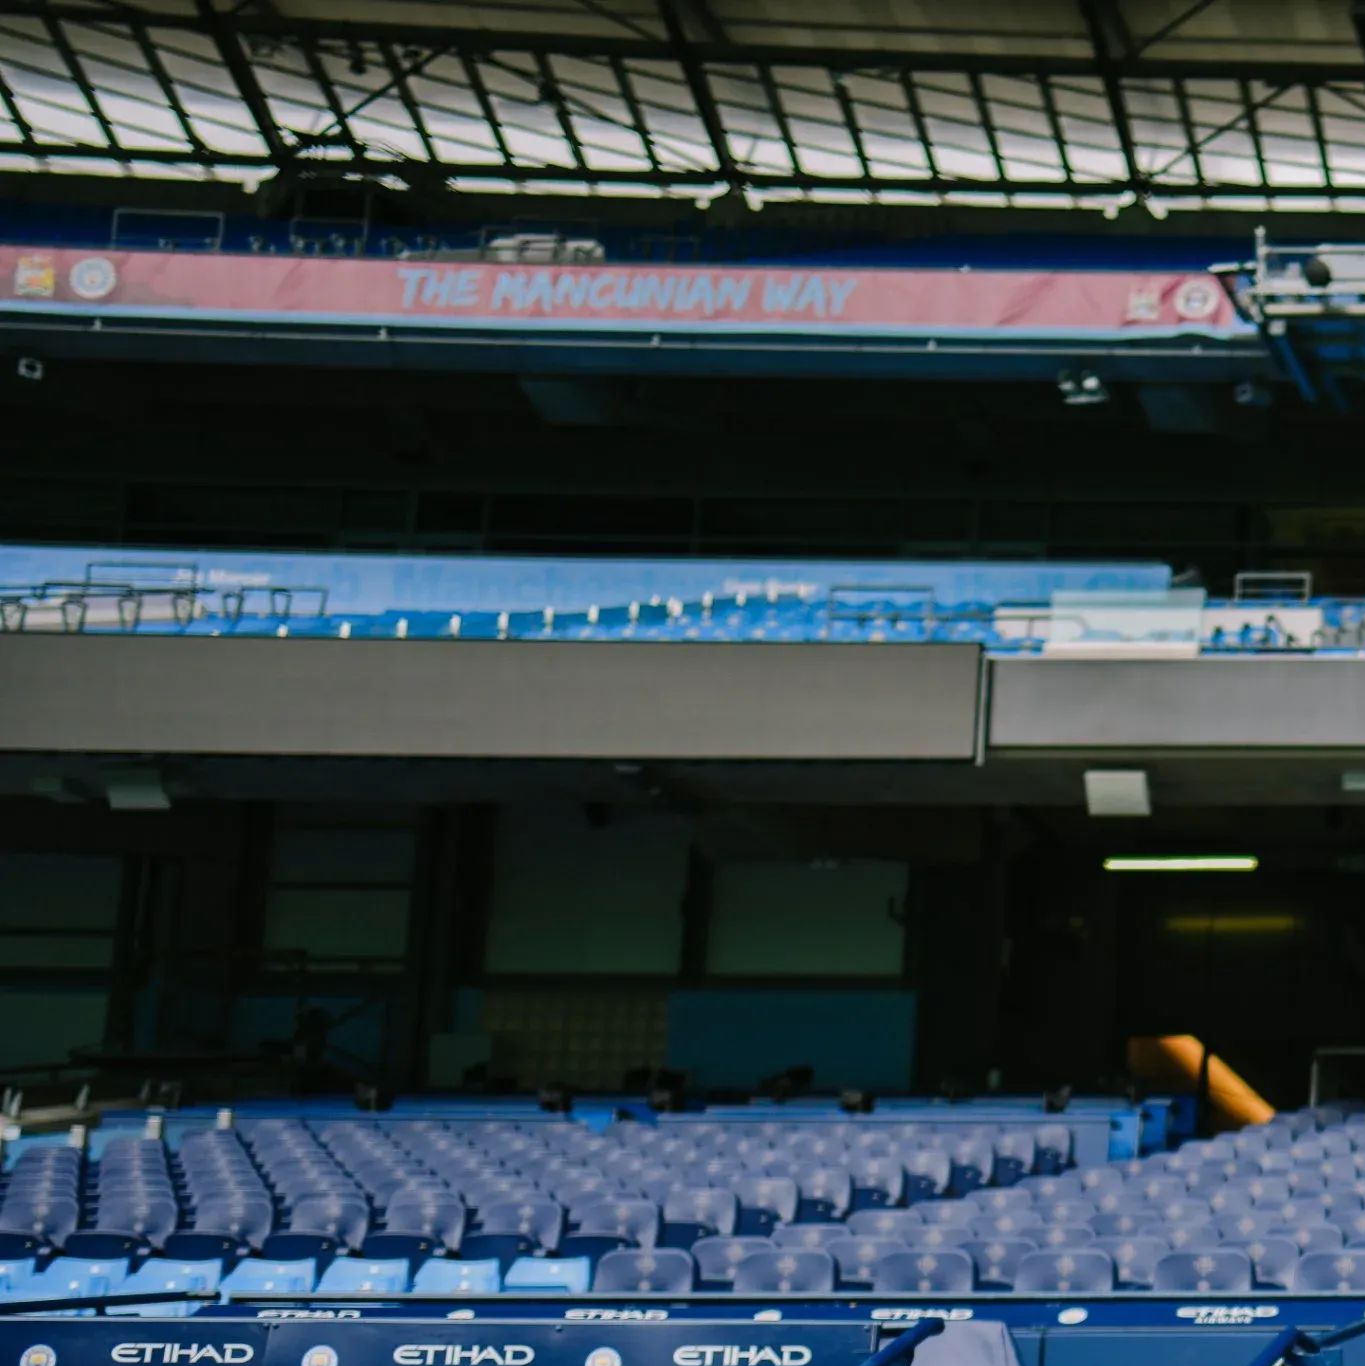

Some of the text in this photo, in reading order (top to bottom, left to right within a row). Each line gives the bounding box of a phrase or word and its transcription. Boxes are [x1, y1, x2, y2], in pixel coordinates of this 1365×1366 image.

[398, 267, 857, 316] THE MANCUNIAN WAY
[1176, 1306, 1278, 1317] ETIHAD
[111, 1343, 254, 1364] ETIHAD
[392, 1344, 535, 1366] ETIHAD
[673, 1345, 812, 1366] ETIHAD
